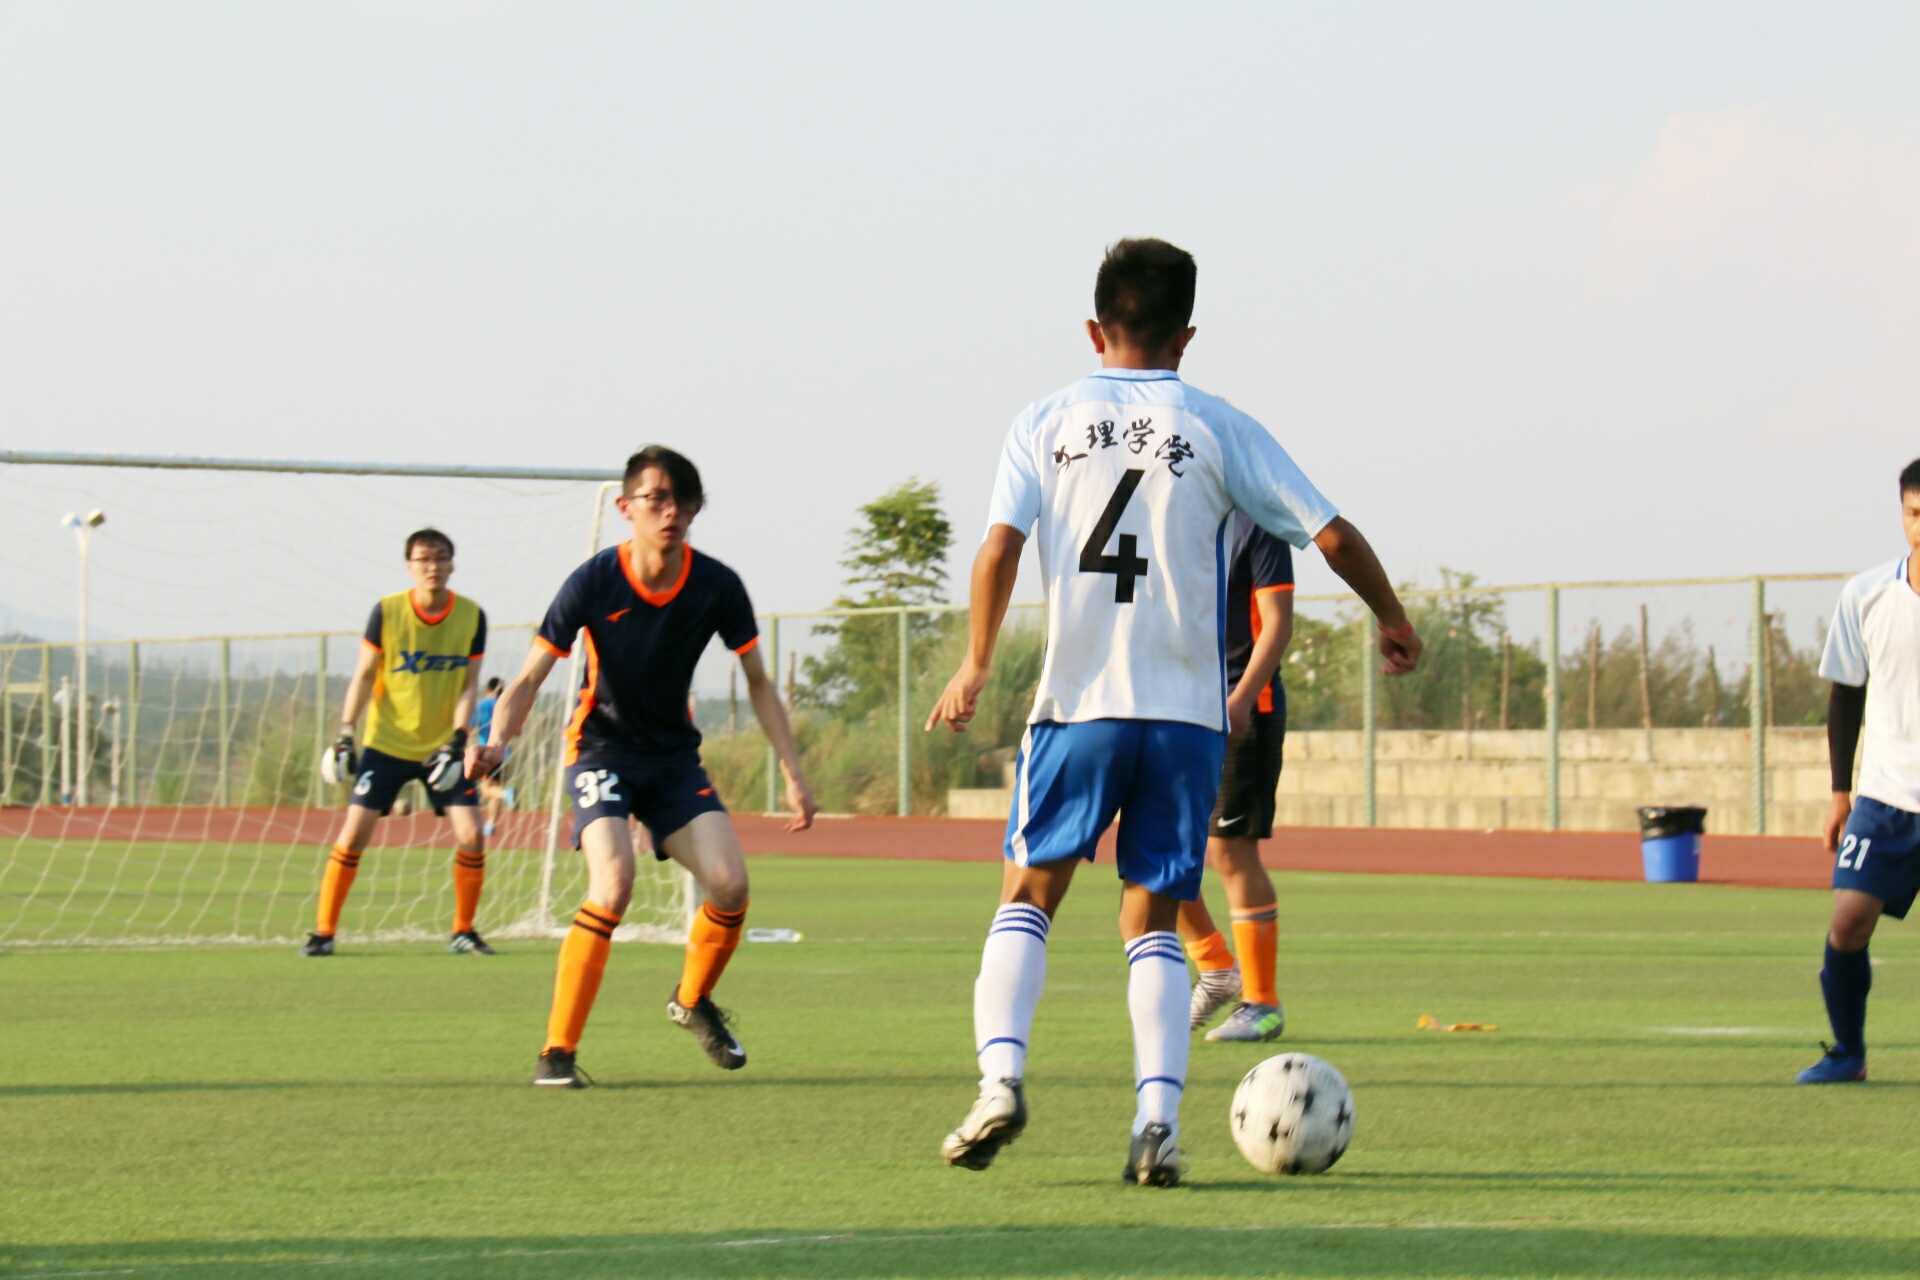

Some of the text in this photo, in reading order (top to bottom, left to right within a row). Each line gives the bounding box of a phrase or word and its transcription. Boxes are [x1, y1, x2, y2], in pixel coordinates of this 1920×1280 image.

[1078, 468, 1149, 604] 4
[391, 649, 469, 674] XTEP
[353, 769, 375, 796] 6
[574, 768, 622, 809] 32
[1837, 833, 1872, 872] 21
